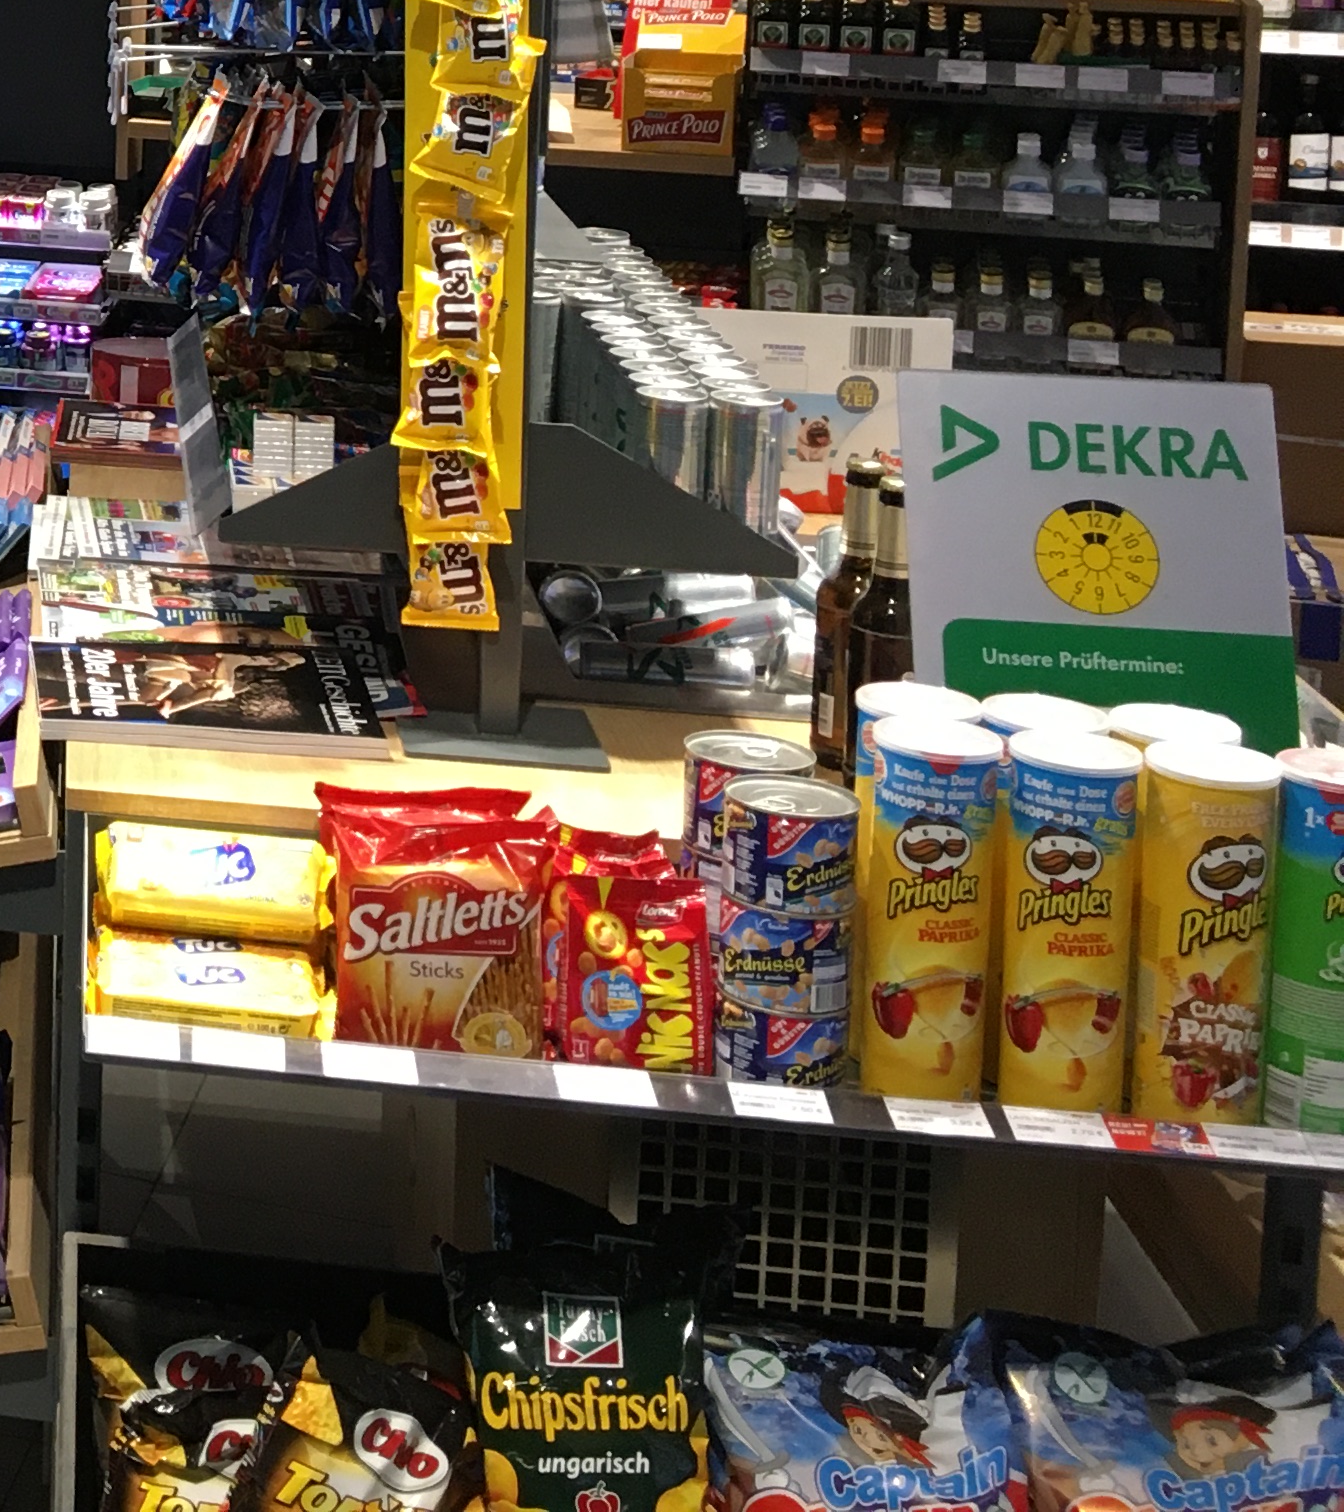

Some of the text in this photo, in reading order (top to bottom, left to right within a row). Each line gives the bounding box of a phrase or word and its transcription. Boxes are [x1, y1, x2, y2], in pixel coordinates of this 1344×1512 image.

[1027, 420, 1249, 482] DEKRA
[1069, 518, 1080, 530] 1
[1087, 513, 1103, 529] 12
[1108, 518, 1122, 534] 11
[1054, 531, 1069, 544] 2
[1122, 532, 1140, 550] 10
[1049, 550, 1066, 560] 3
[1128, 554, 1145, 564] 9
[1056, 568, 1069, 578] 4
[1125, 571, 1141, 584] 8
[1075, 580, 1085, 595] 5
[1094, 586, 1105, 601] 6
[1115, 583, 1126, 598] 7
[982, 647, 1184, 676] Unsere Prüftermine:
[80, 648, 125, 718] 20er Jahre
[320, 674, 368, 736] Geschichte
[888, 875, 979, 920] Pringles
[1018, 884, 1112, 932] Pringles
[344, 889, 528, 962] Saltletts
[925, 917, 975, 930] CLASSIC
[918, 928, 980, 944] PAPRIKA
[1053, 931, 1107, 944] CLASSIC
[1047, 941, 1115, 957] PAPRIKA
[724, 948, 807, 975] Erdnüsse
[409, 960, 465, 980] Sticks
[480, 1372, 688, 1443] Chipsfrisch
[538, 1451, 650, 1480] ungarisch
[815, 1445, 1008, 1510] Captain
